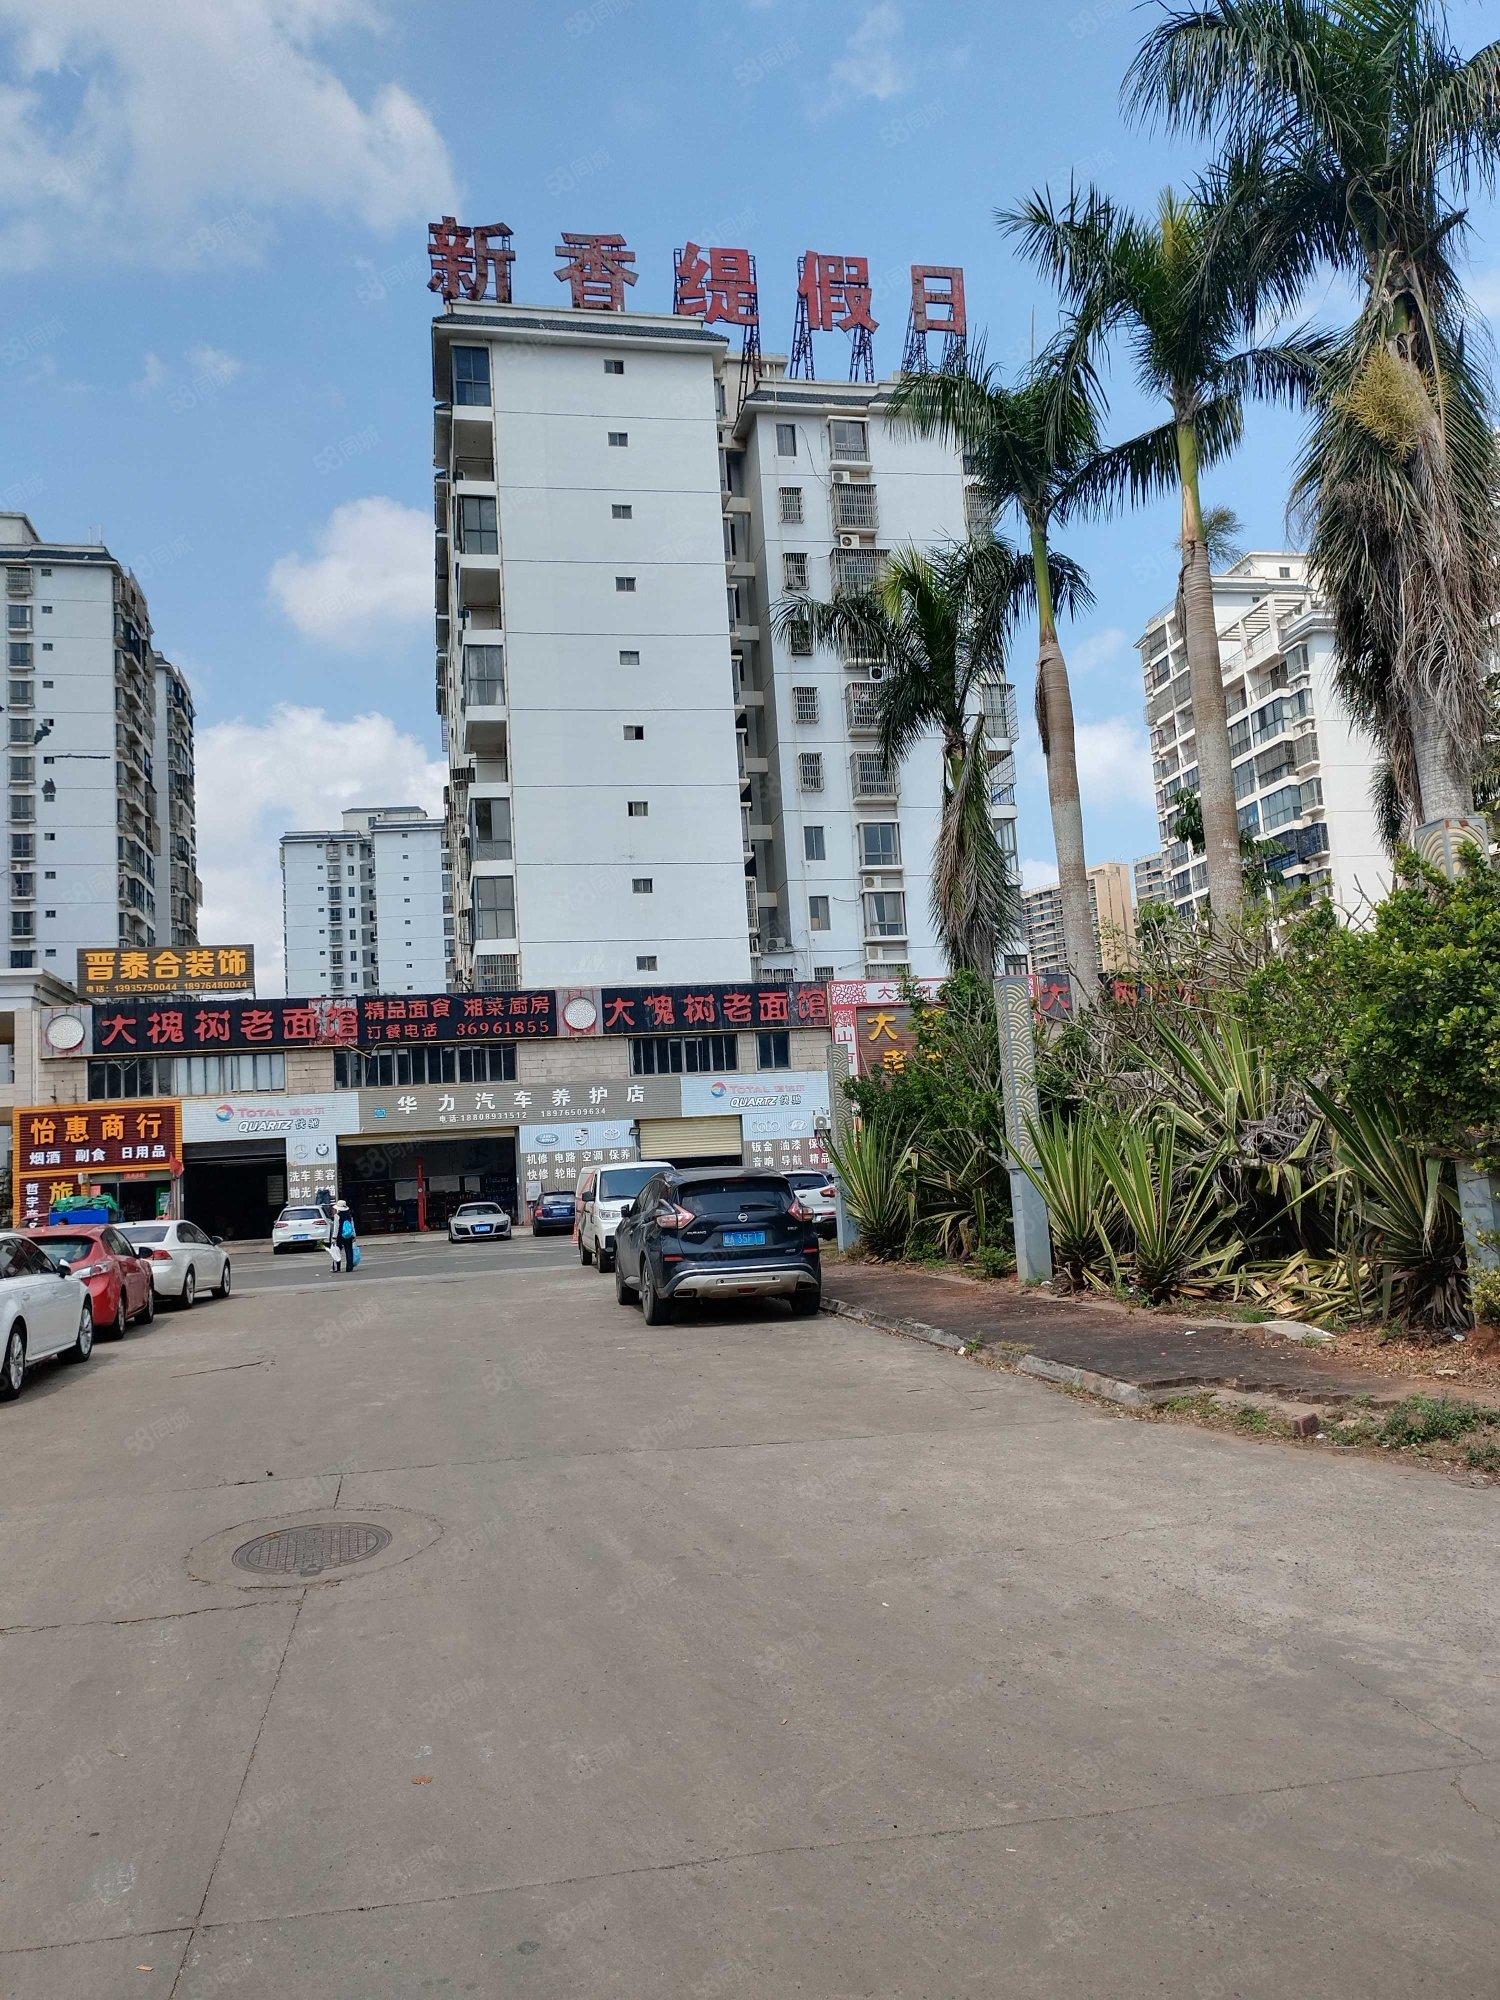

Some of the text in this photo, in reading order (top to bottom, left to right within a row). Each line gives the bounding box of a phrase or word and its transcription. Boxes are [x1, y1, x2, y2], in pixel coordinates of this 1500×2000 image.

[427, 215, 966, 337] 新香缇假日
[84, 950, 247, 982] 晋泰合装饰
[114, 983, 178, 992] 13935750044
[184, 981, 247, 990] 18976480044
[364, 995, 550, 1021] 精品面食 湘菜厨房
[604, 989, 826, 1027] 大槐树老面馆
[101, 1007, 359, 1046] 大槐树老面馆
[367, 1020, 550, 1040] 订餐电话 36961855
[397, 1084, 645, 1115] 华力汽车养护店
[729, 1096, 779, 1108] QUARTZ
[541, 1107, 606, 1118] 18976509634
[30, 1112, 162, 1145] 怡惠商行
[238, 1119, 293, 1133] QUARTZ
[29, 1144, 166, 1165] 烟酒 副食 日用品
[752, 1141, 773, 1153] 钣金
[780, 1139, 801, 1151] 油漆
[526, 1148, 631, 1165] 机修 电路 空调 保养
[753, 1152, 830, 1168] 音响 导航 精品
[289, 1170, 311, 1182] 洗车
[314, 1169, 335, 1181] 美容
[527, 1167, 577, 1180] 快修 轮胎
[289, 1186, 311, 1199] 抛光
